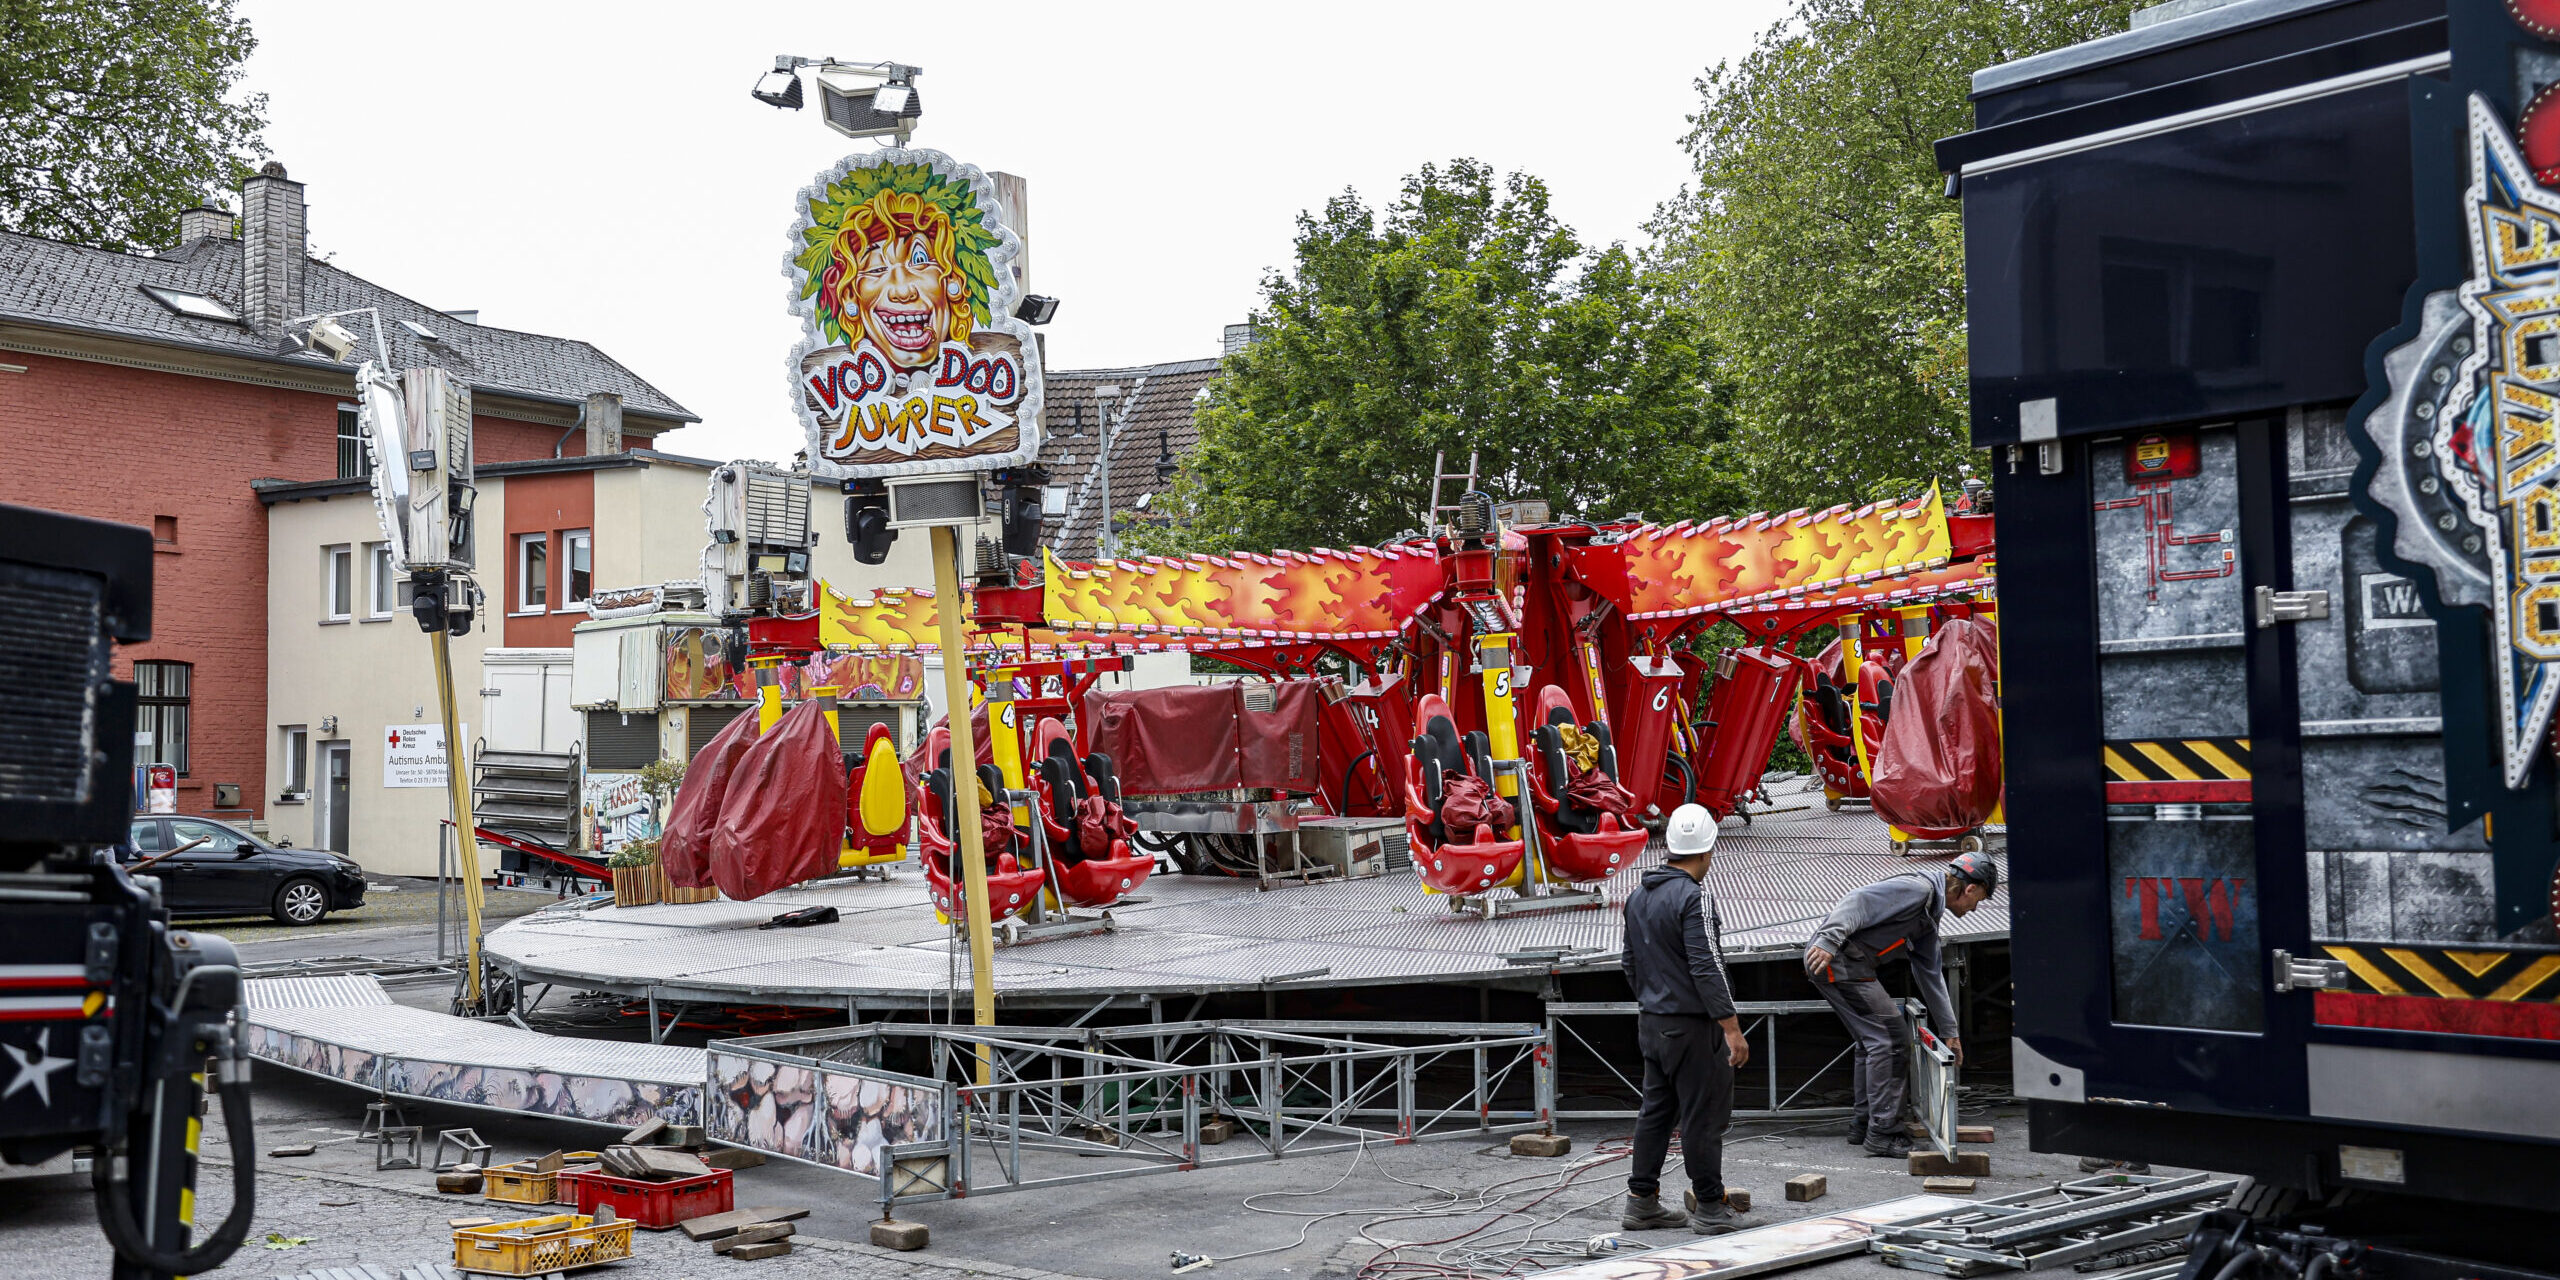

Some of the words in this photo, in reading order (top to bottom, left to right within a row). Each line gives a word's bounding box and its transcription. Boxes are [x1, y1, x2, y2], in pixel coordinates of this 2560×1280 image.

[809, 352, 887, 411] VOO
[935, 348, 1016, 400] DOO
[834, 394, 991, 450] JUMPER
[1494, 671, 1509, 697] 5
[1769, 676, 1782, 703] 7
[1652, 686, 1668, 711] 6
[1001, 703, 1015, 729] 4
[1364, 705, 1379, 729] 4
[388, 754, 423, 766] Autismus
[610, 779, 639, 811] KASSE
[2124, 876, 2248, 942] TW
